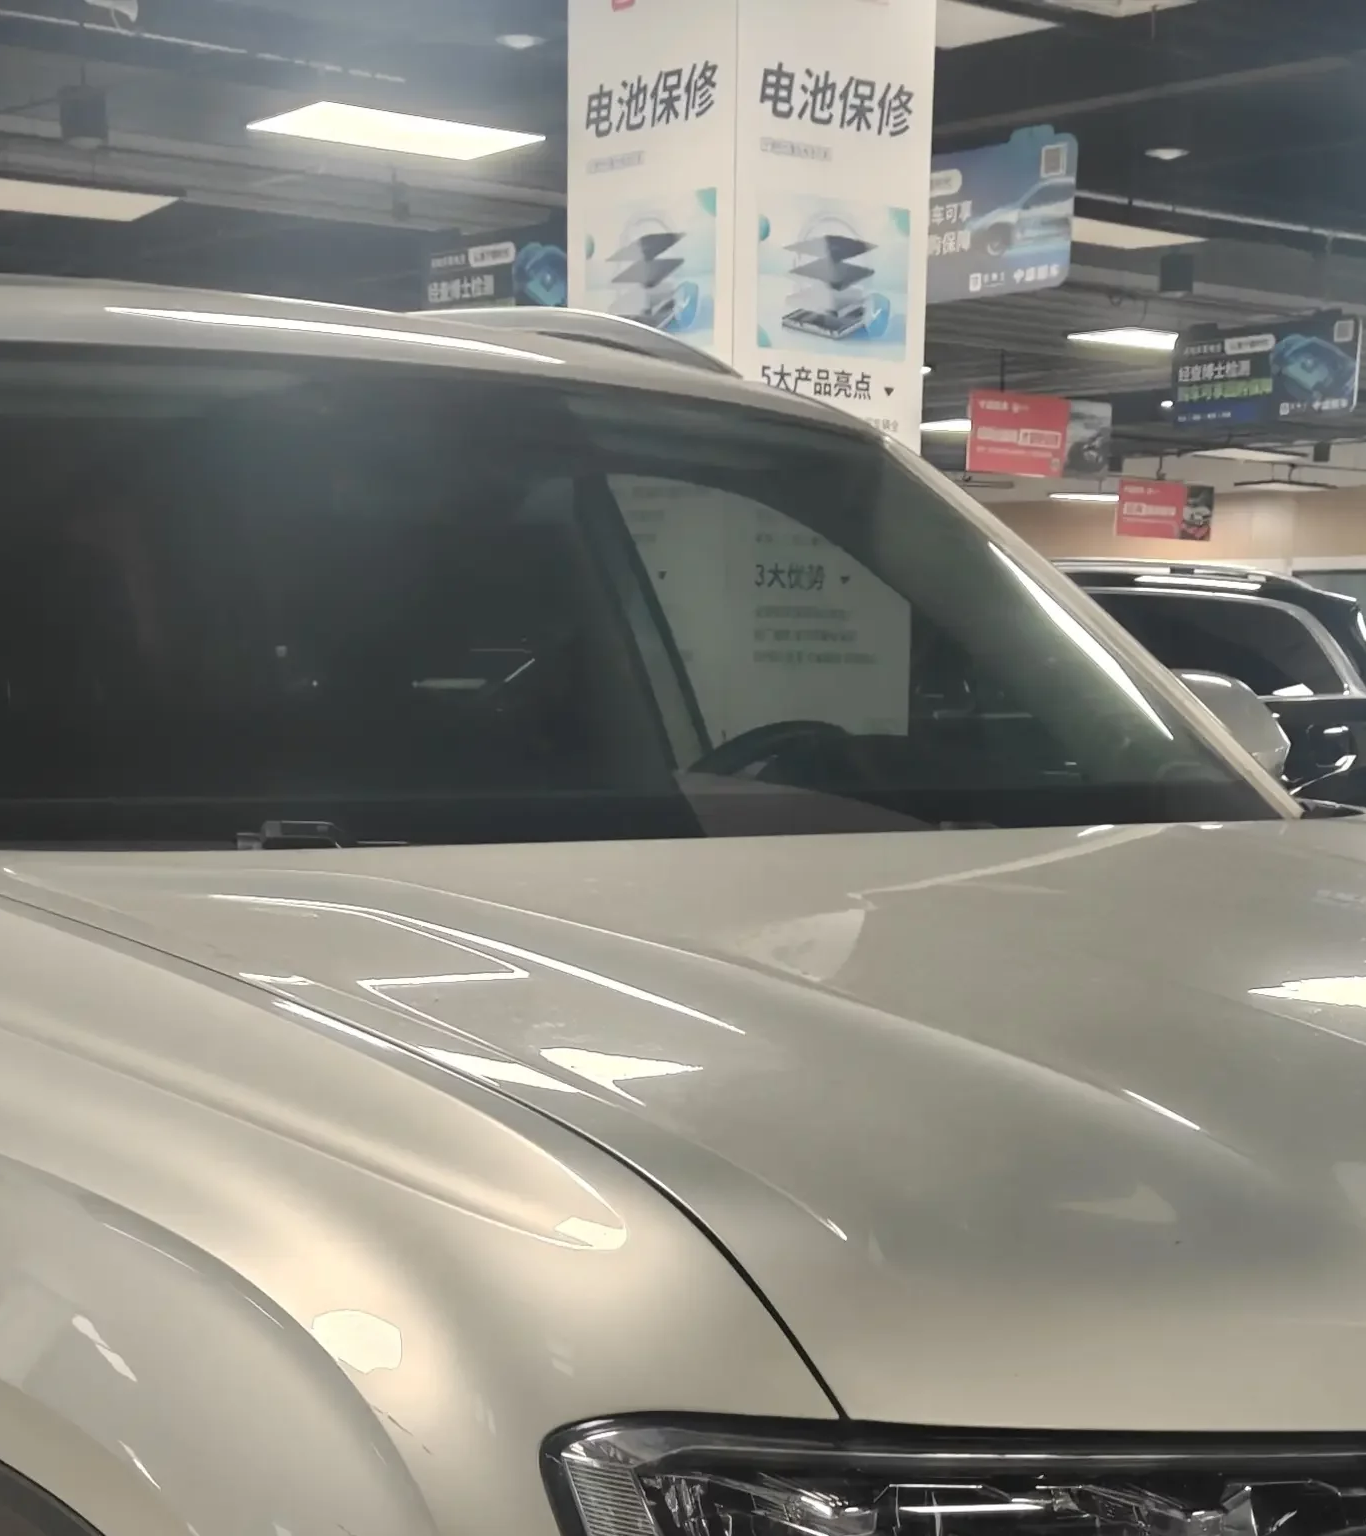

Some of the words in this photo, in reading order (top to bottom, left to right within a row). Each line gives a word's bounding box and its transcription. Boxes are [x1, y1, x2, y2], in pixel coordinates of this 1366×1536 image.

[585, 60, 719, 139] 电池保修
[758, 61, 914, 137] 电池保修
[761, 364, 872, 400] 5大产品亮点
[754, 563, 826, 591] 3大优势
